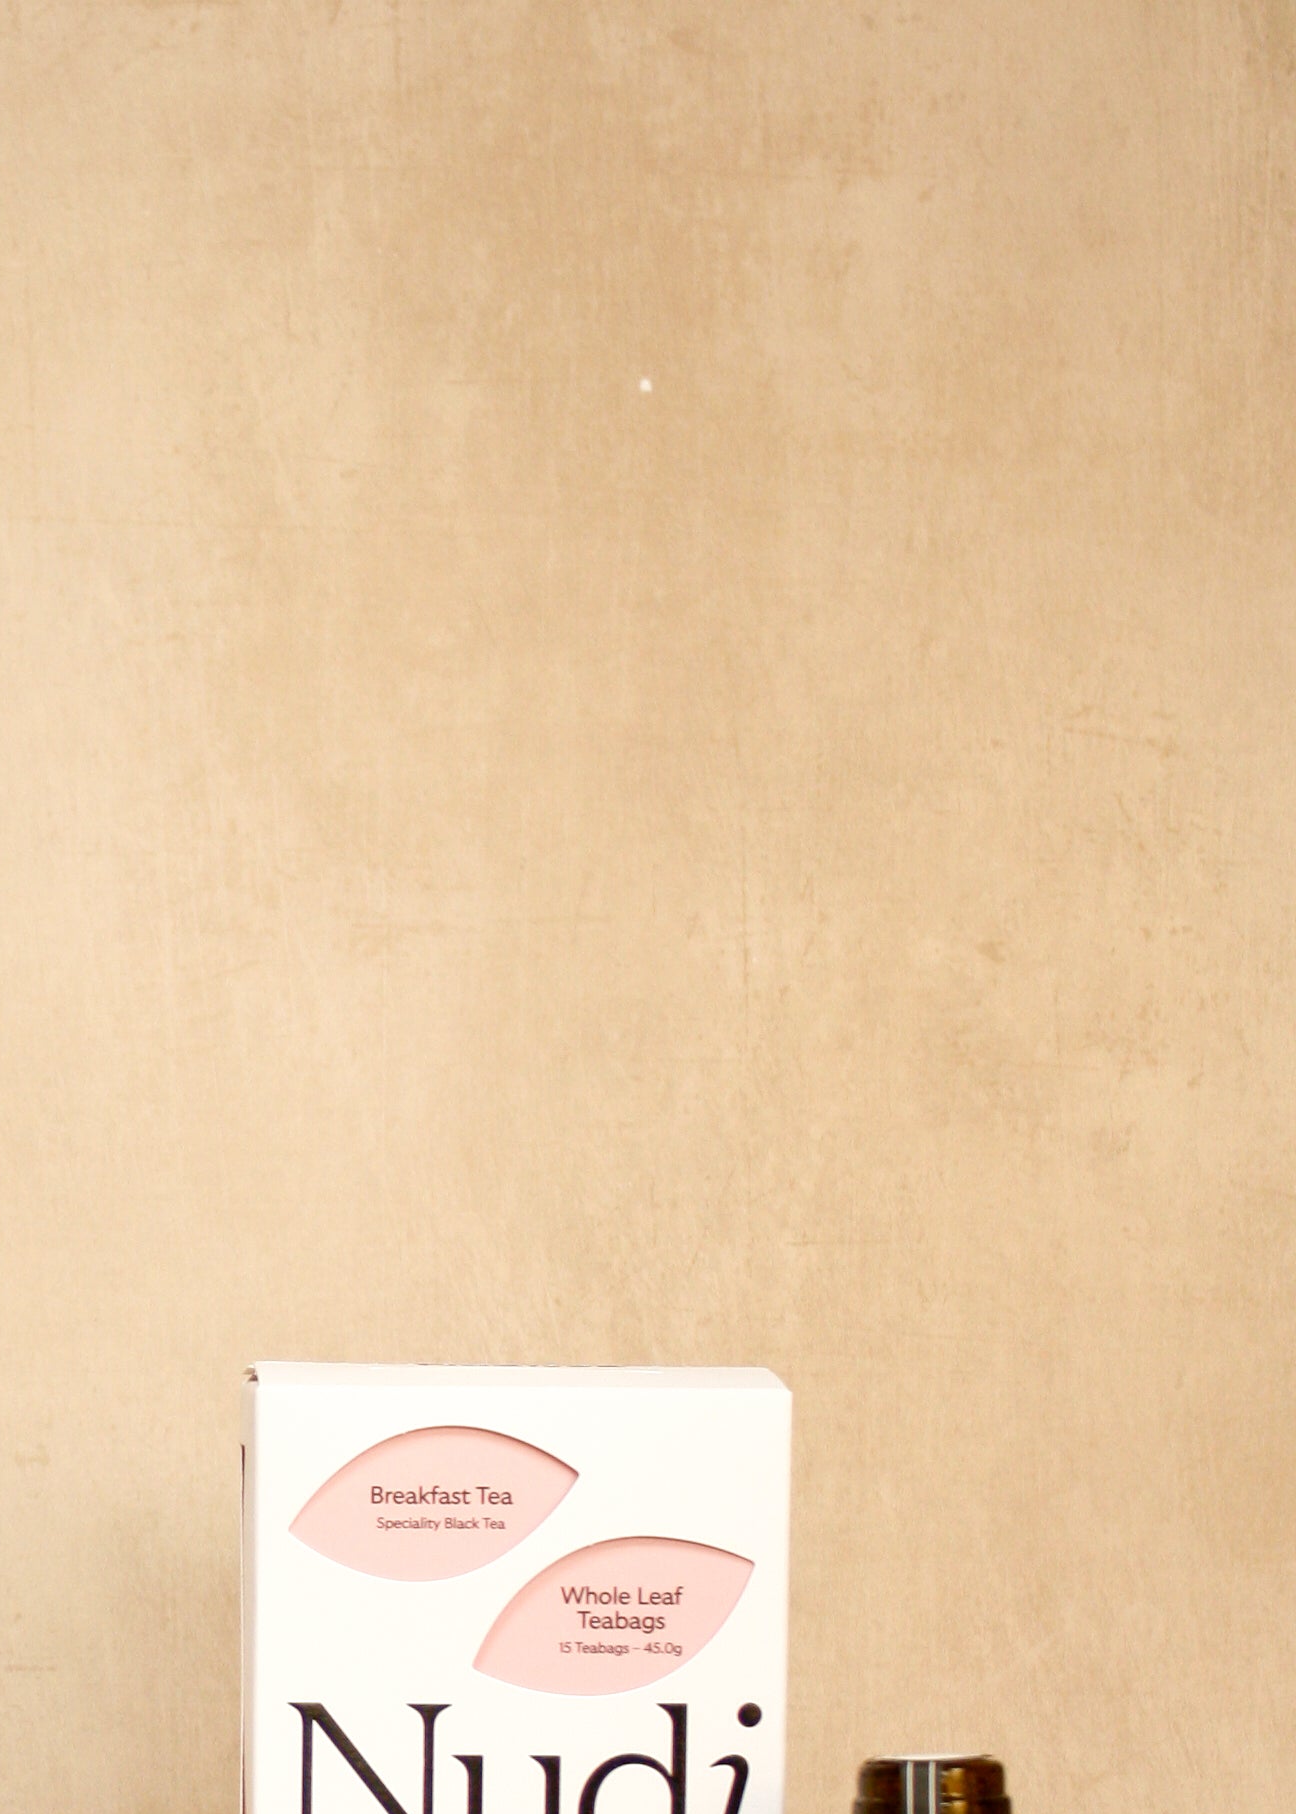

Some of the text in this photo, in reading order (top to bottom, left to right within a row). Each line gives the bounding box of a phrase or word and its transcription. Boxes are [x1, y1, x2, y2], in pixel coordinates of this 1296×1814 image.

[370, 1486, 513, 1506] Breakfast Tea
[376, 1517, 506, 1531] Speciality Black Tea
[561, 1586, 684, 1605] Whole Leaf
[577, 1611, 665, 1633] Teabags
[559, 1642, 572, 1654] 15
[575, 1642, 630, 1657] Teabags
